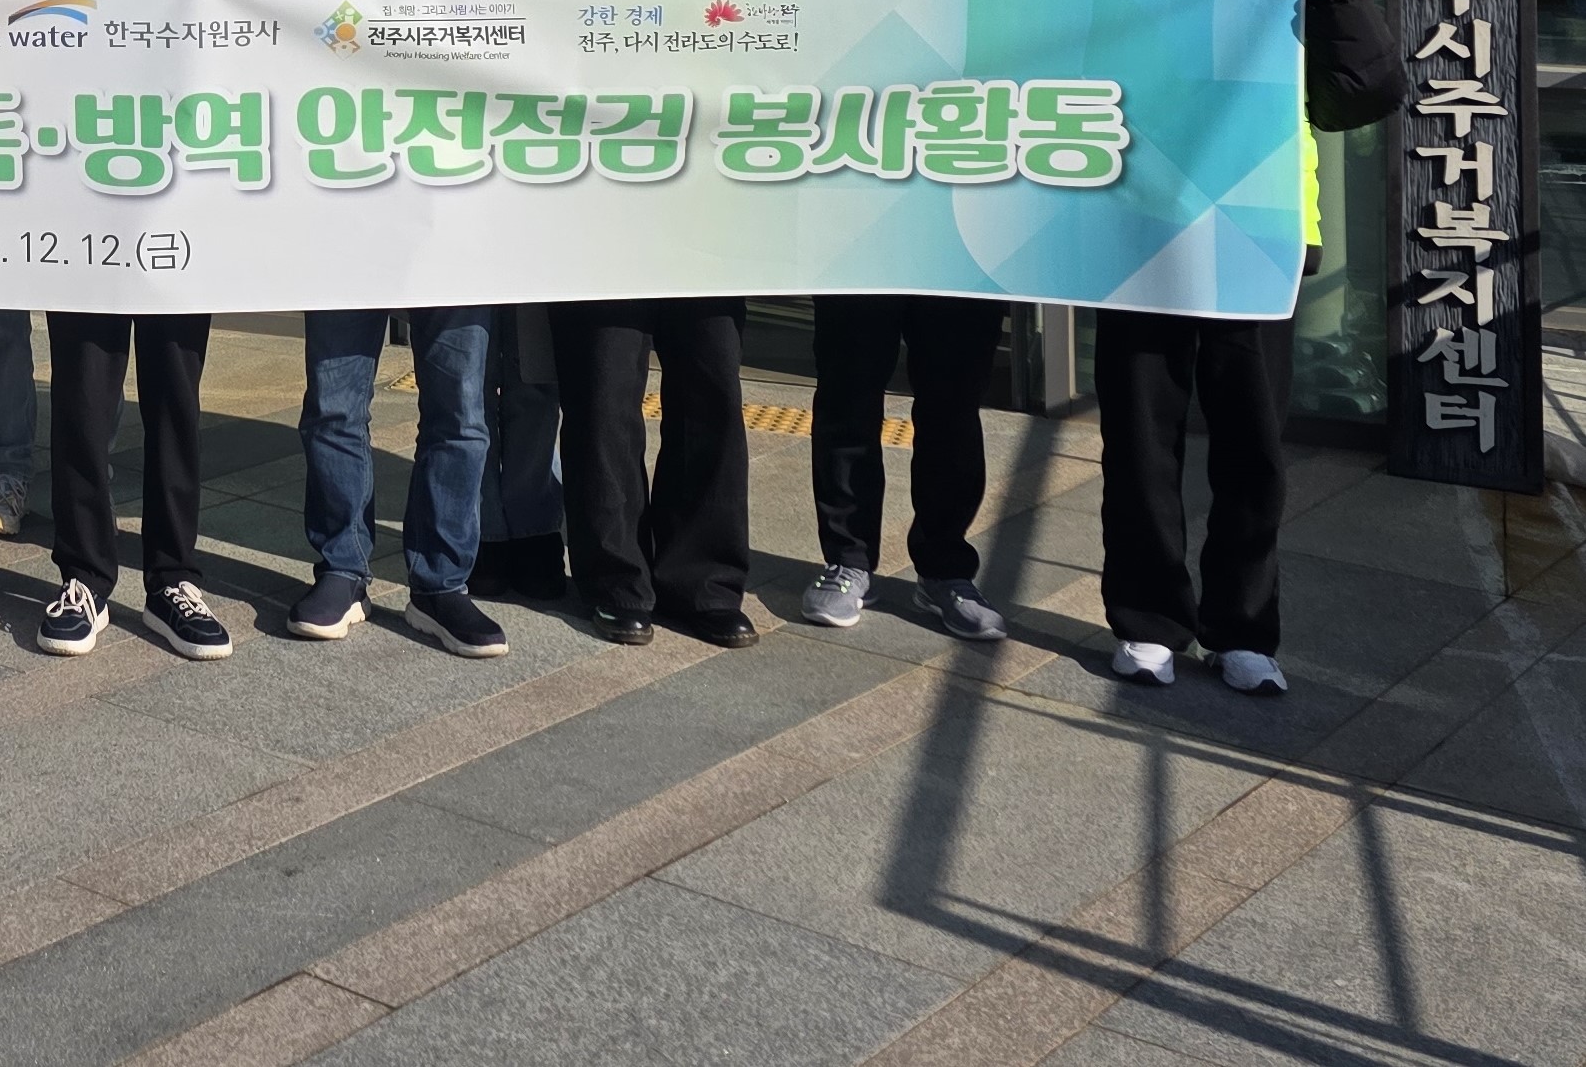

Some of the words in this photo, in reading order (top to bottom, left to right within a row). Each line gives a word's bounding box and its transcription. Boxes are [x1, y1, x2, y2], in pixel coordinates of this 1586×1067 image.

[382, 5, 393, 16] 집
[398, 4, 416, 16] 희망
[421, 4, 448, 16] 그리고
[449, 4, 467, 16] 사람
[469, 4, 488, 15] 사는
[489, 3, 515, 15] 이야기
[577, 5, 618, 27] 강한
[625, 5, 663, 27] 경제
[8, 25, 89, 48] water
[104, 20, 281, 49] 한국수자원공사
[367, 25, 527, 47] 전주시주거복지센터
[577, 31, 619, 53] 전주,
[623, 31, 659, 53] 다시
[663, 30, 734, 53] 전라도의
[737, 31, 799, 53] 수도로!
[383, 50, 413, 60] Jeonju
[414, 51, 450, 62] Housing
[451, 51, 482, 61] Welfare
[483, 51, 511, 60] Center
[294, 85, 690, 186] 안전점검
[715, 84, 1123, 180] 봉사활동
[20, 231, 70, 265] 12.
[81, 229, 192, 271] 12.(금)
